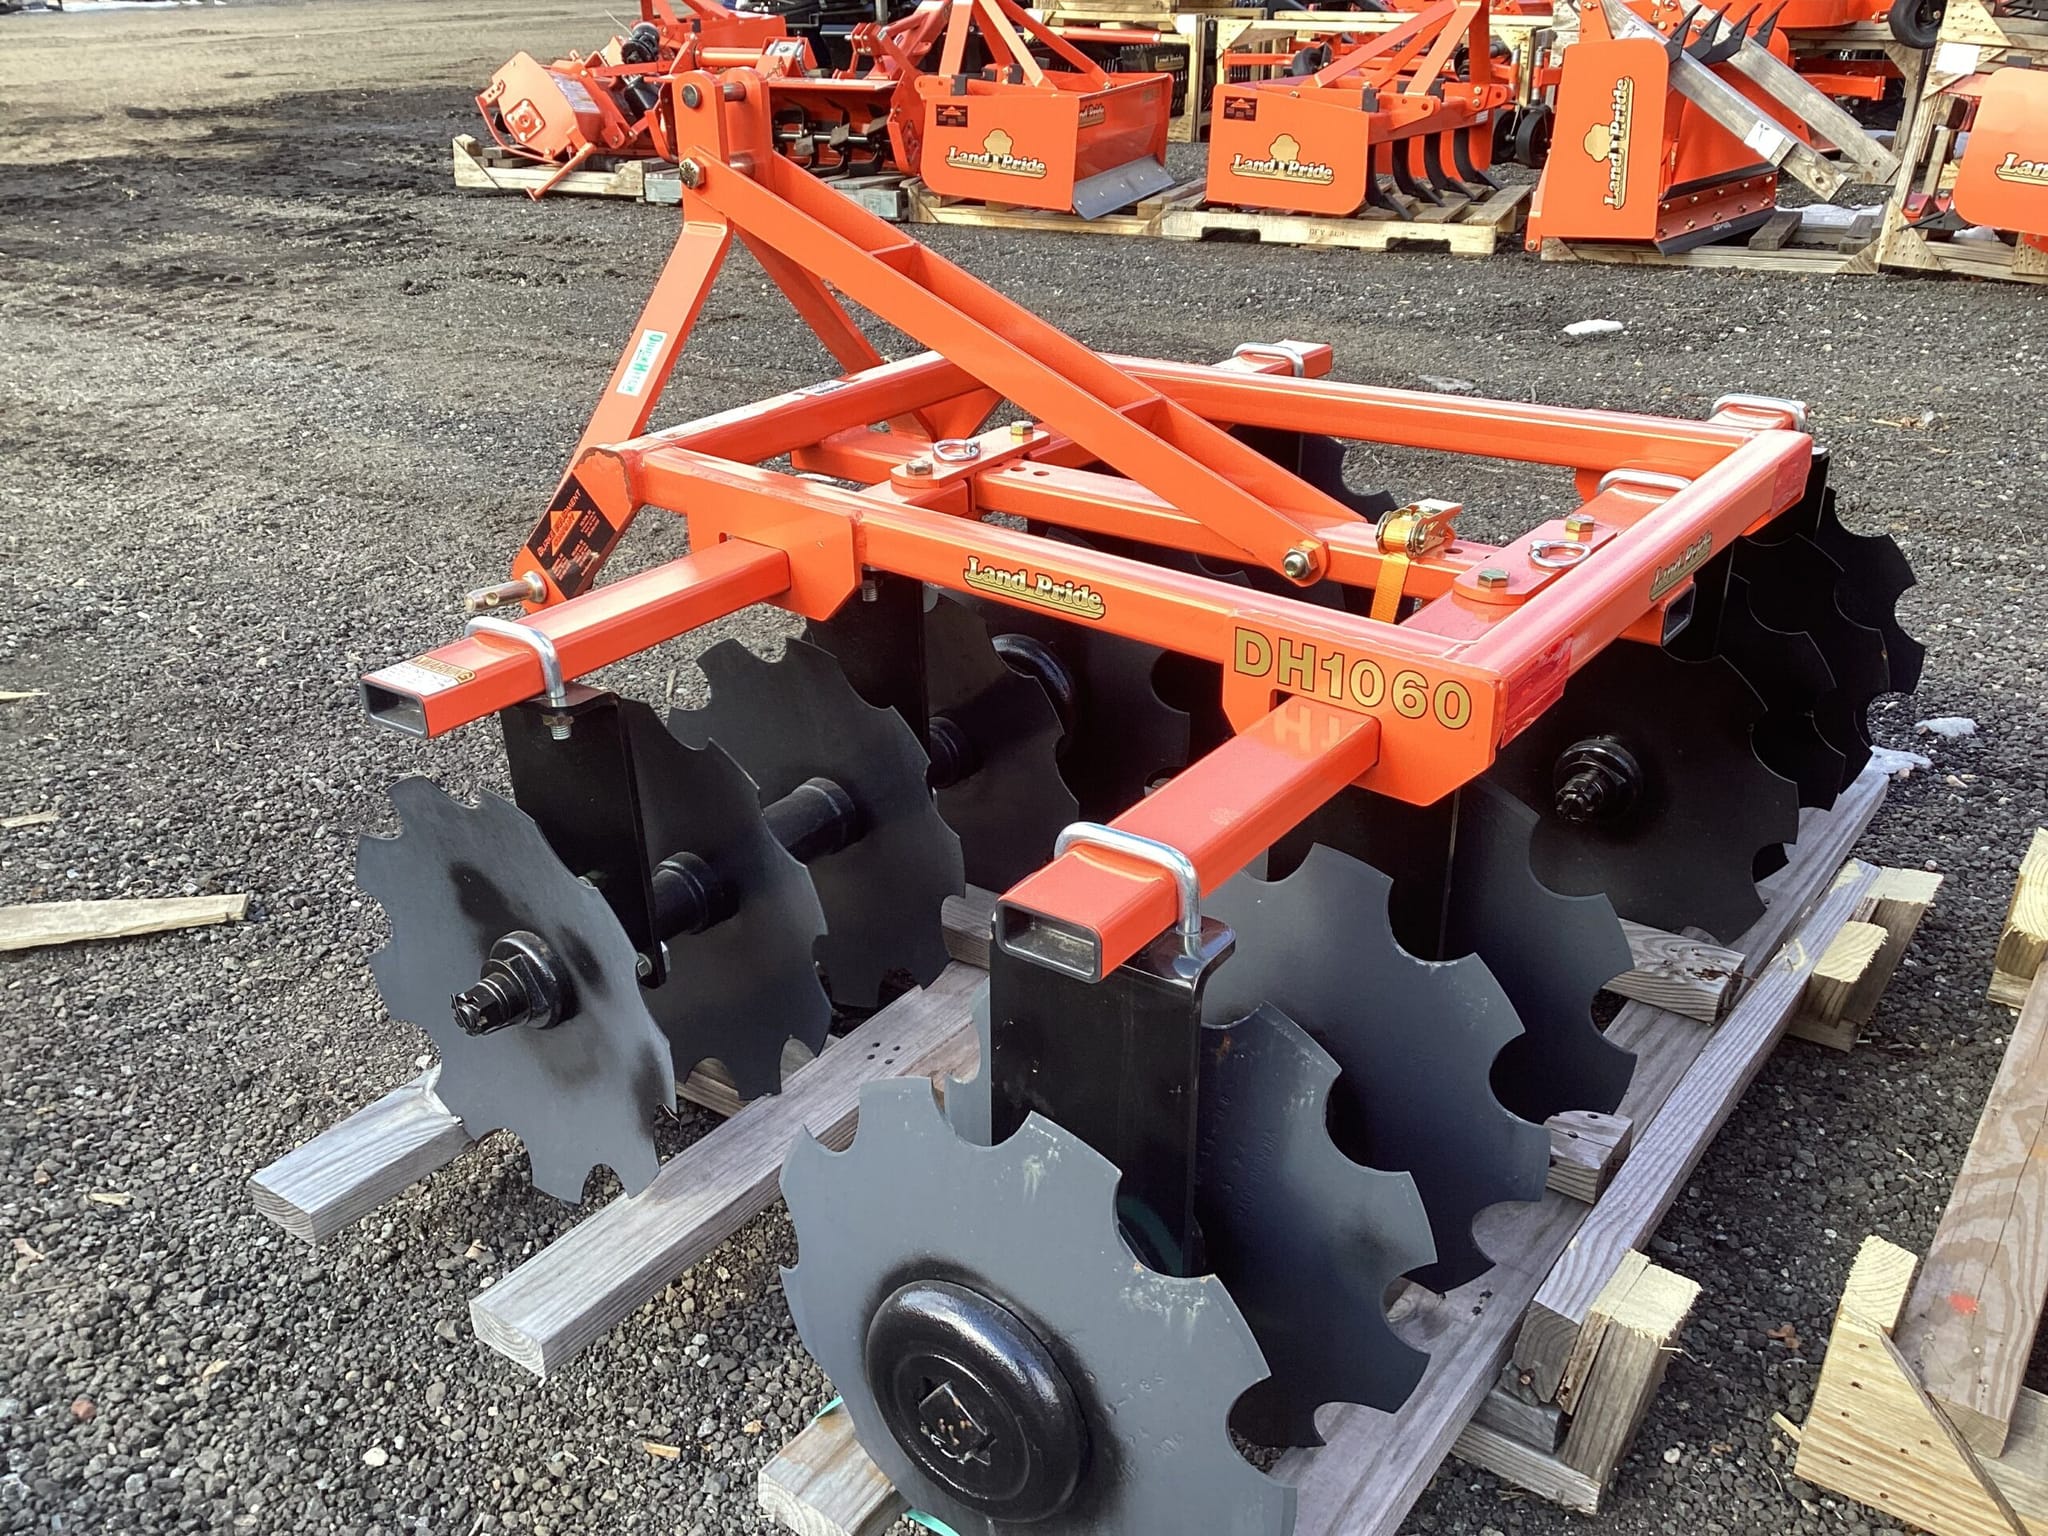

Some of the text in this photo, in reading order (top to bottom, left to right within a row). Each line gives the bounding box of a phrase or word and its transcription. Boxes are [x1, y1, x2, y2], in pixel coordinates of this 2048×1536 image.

[948, 146, 1047, 173] Land Pride
[1603, 78, 1629, 206] Land Pride
[1233, 153, 1334, 180] Land Pride
[2000, 152, 2048, 176] Lan
[967, 556, 1103, 610] Land Pride
[1234, 626, 1472, 730] DH1060
